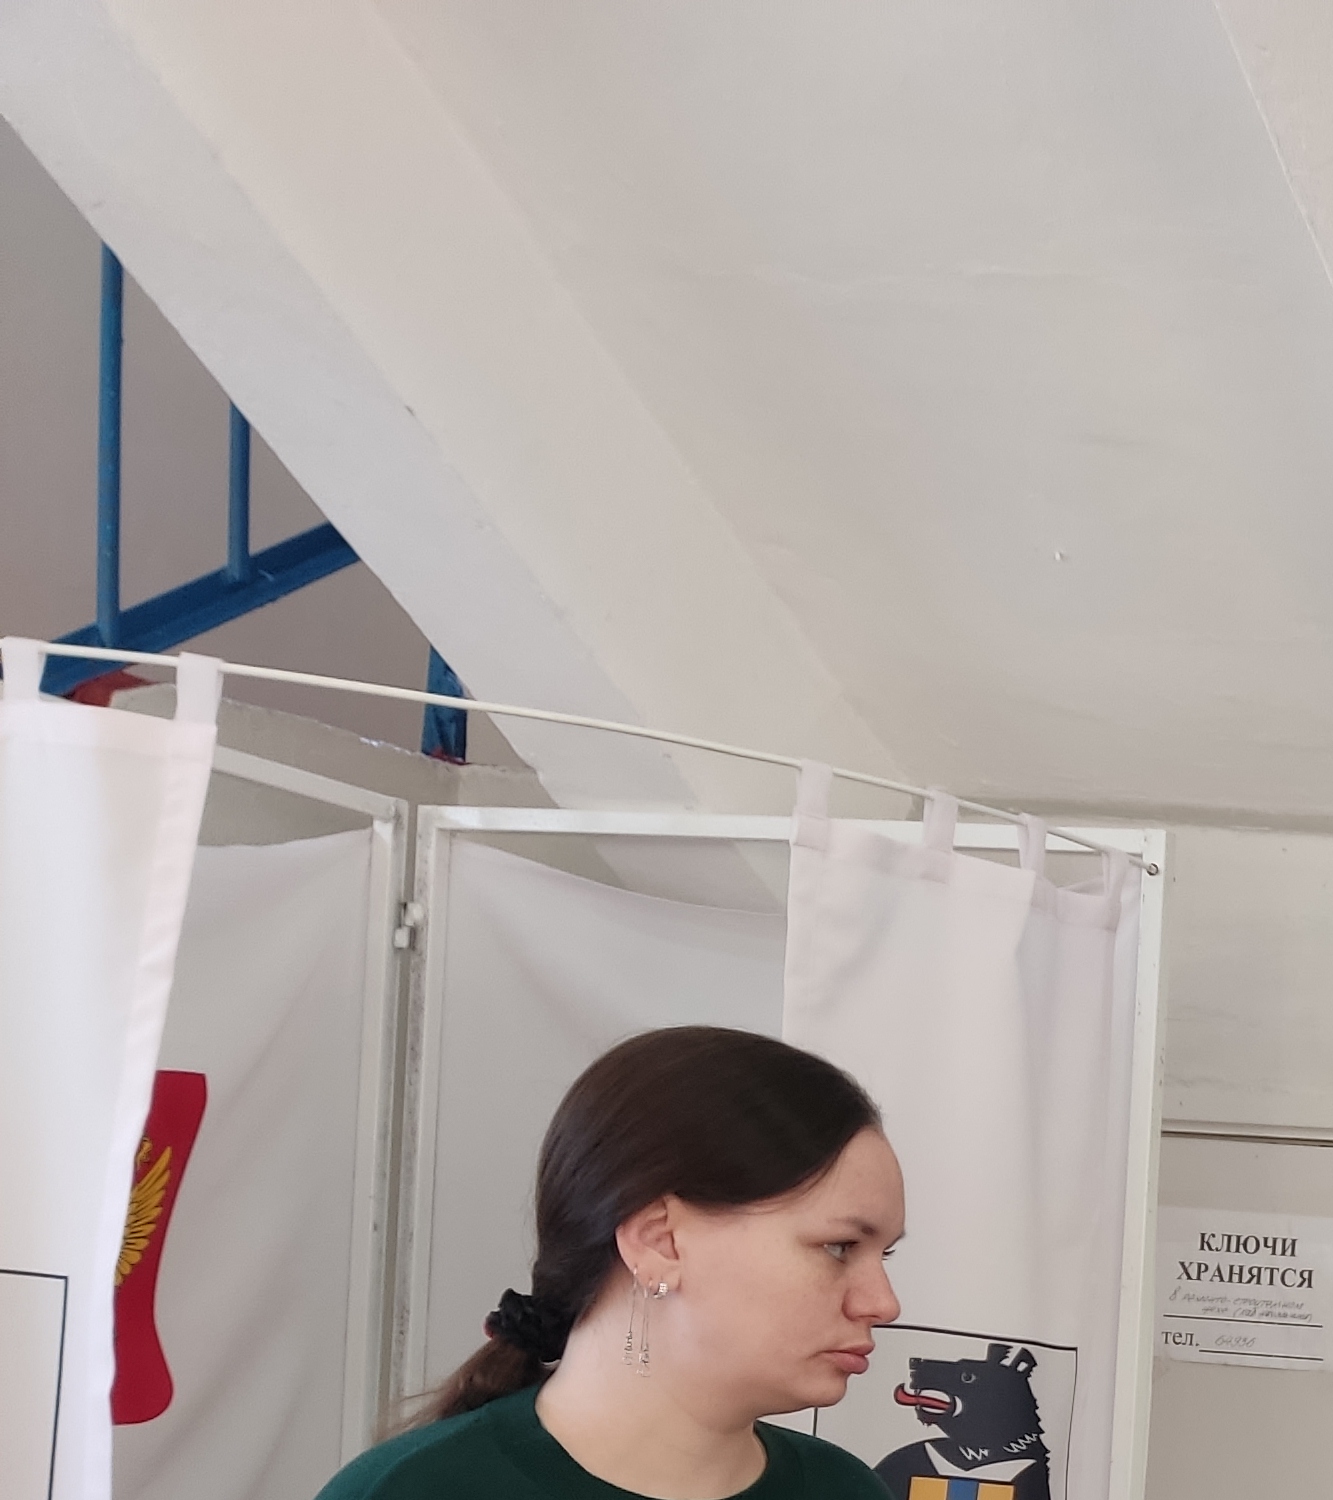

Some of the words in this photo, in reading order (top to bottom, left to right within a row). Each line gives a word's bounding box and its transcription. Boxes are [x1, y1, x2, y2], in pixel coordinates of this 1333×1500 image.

[1199, 1232, 1298, 1257] КЛЮЧИ
[1177, 1261, 1314, 1289] ХРАНЯТСЯ
[1161, 1331, 1200, 1347] тел.
